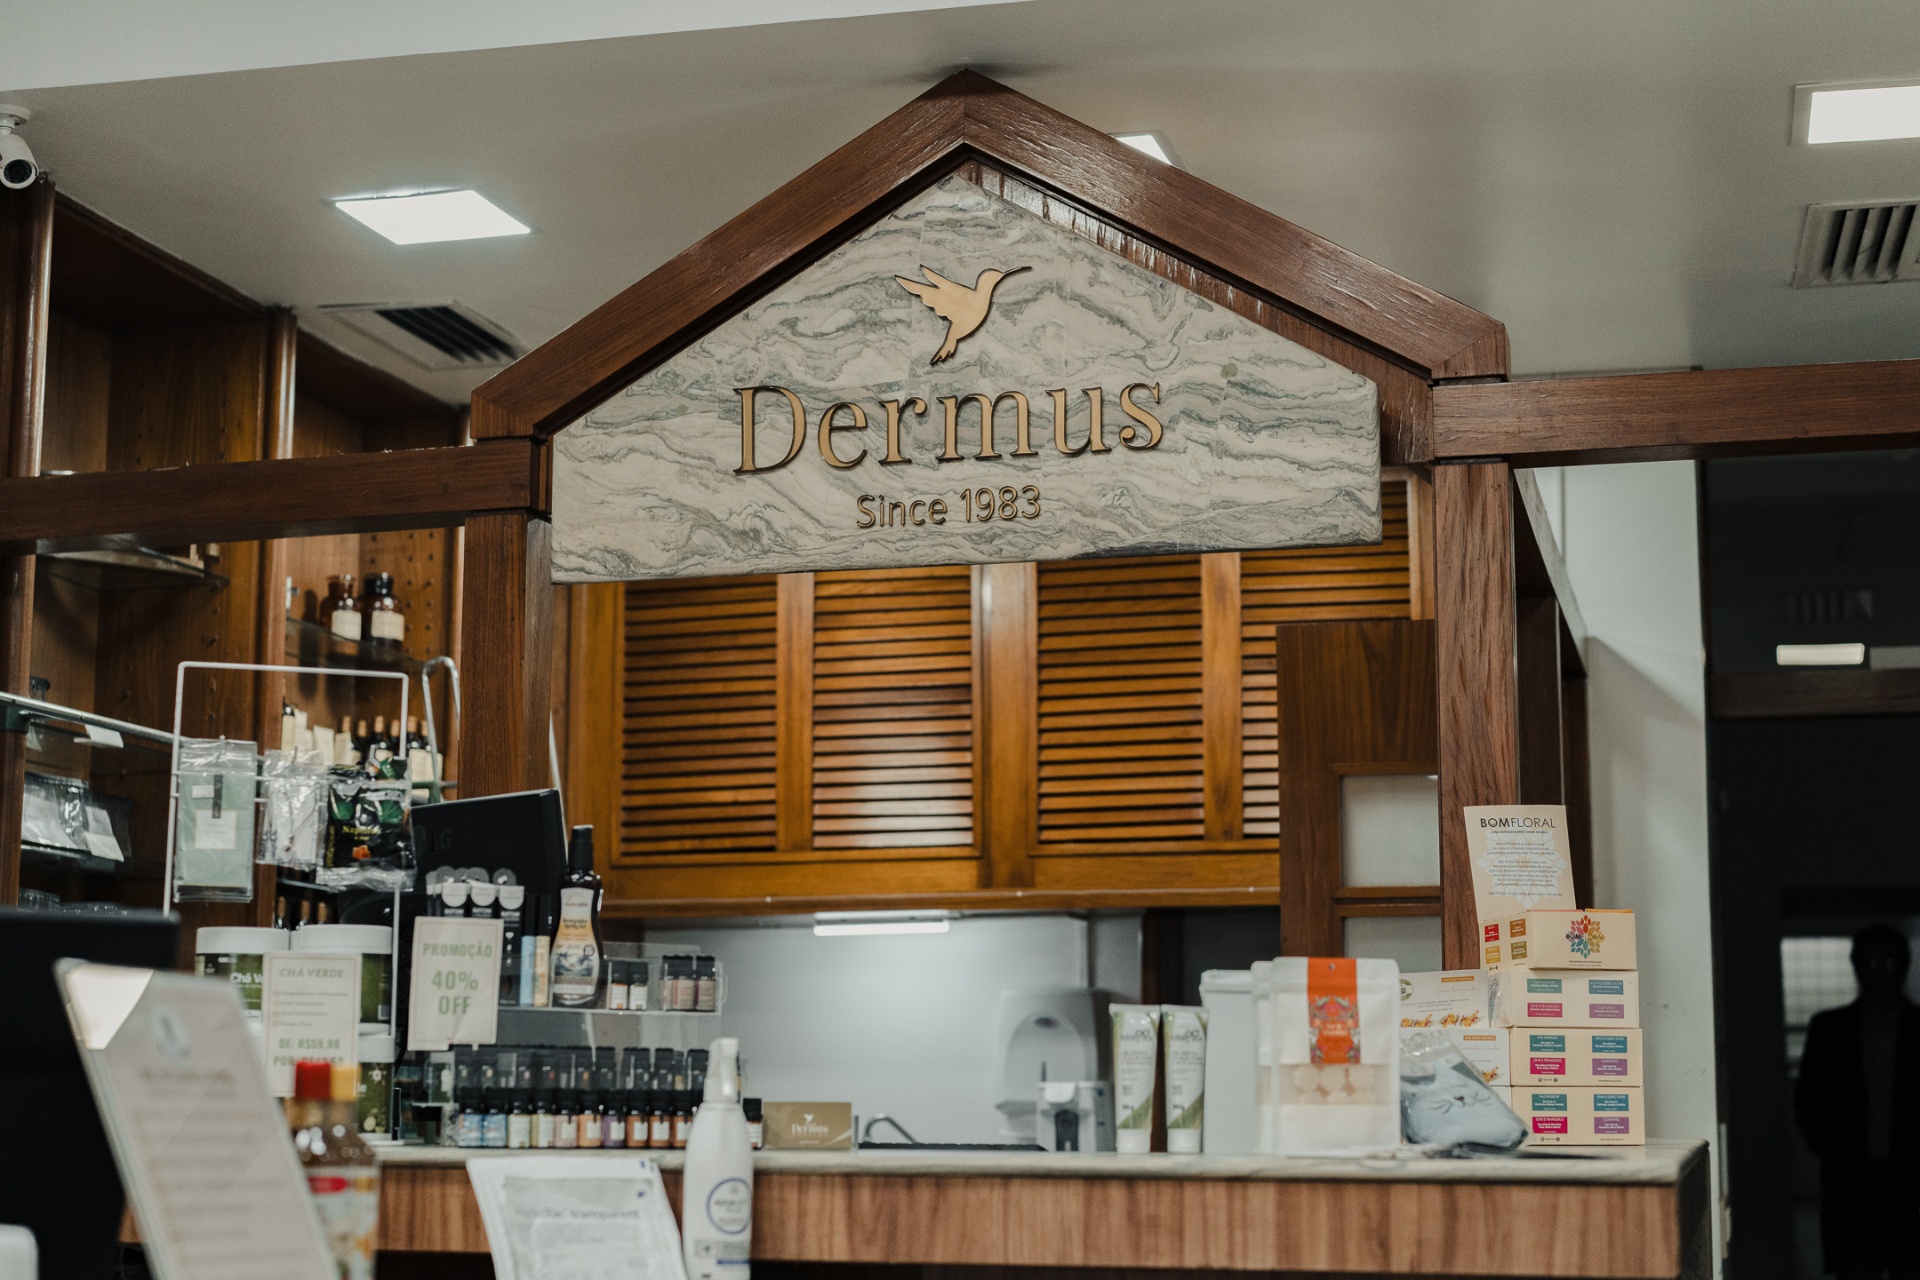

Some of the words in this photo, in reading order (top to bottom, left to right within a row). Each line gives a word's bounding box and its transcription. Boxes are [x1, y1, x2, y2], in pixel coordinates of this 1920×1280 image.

[733, 381, 1164, 475] Dermus
[856, 494, 948, 528] Since
[959, 485, 1041, 522] 1983
[1480, 817, 1556, 829] BOMFLORAL
[422, 941, 493, 960] PROMOÇÃO
[230, 972, 252, 983] Chá
[279, 967, 305, 978] CHÁ
[306, 968, 345, 978] VERDE
[431, 970, 479, 991] 40%
[438, 995, 472, 1015] OFF
